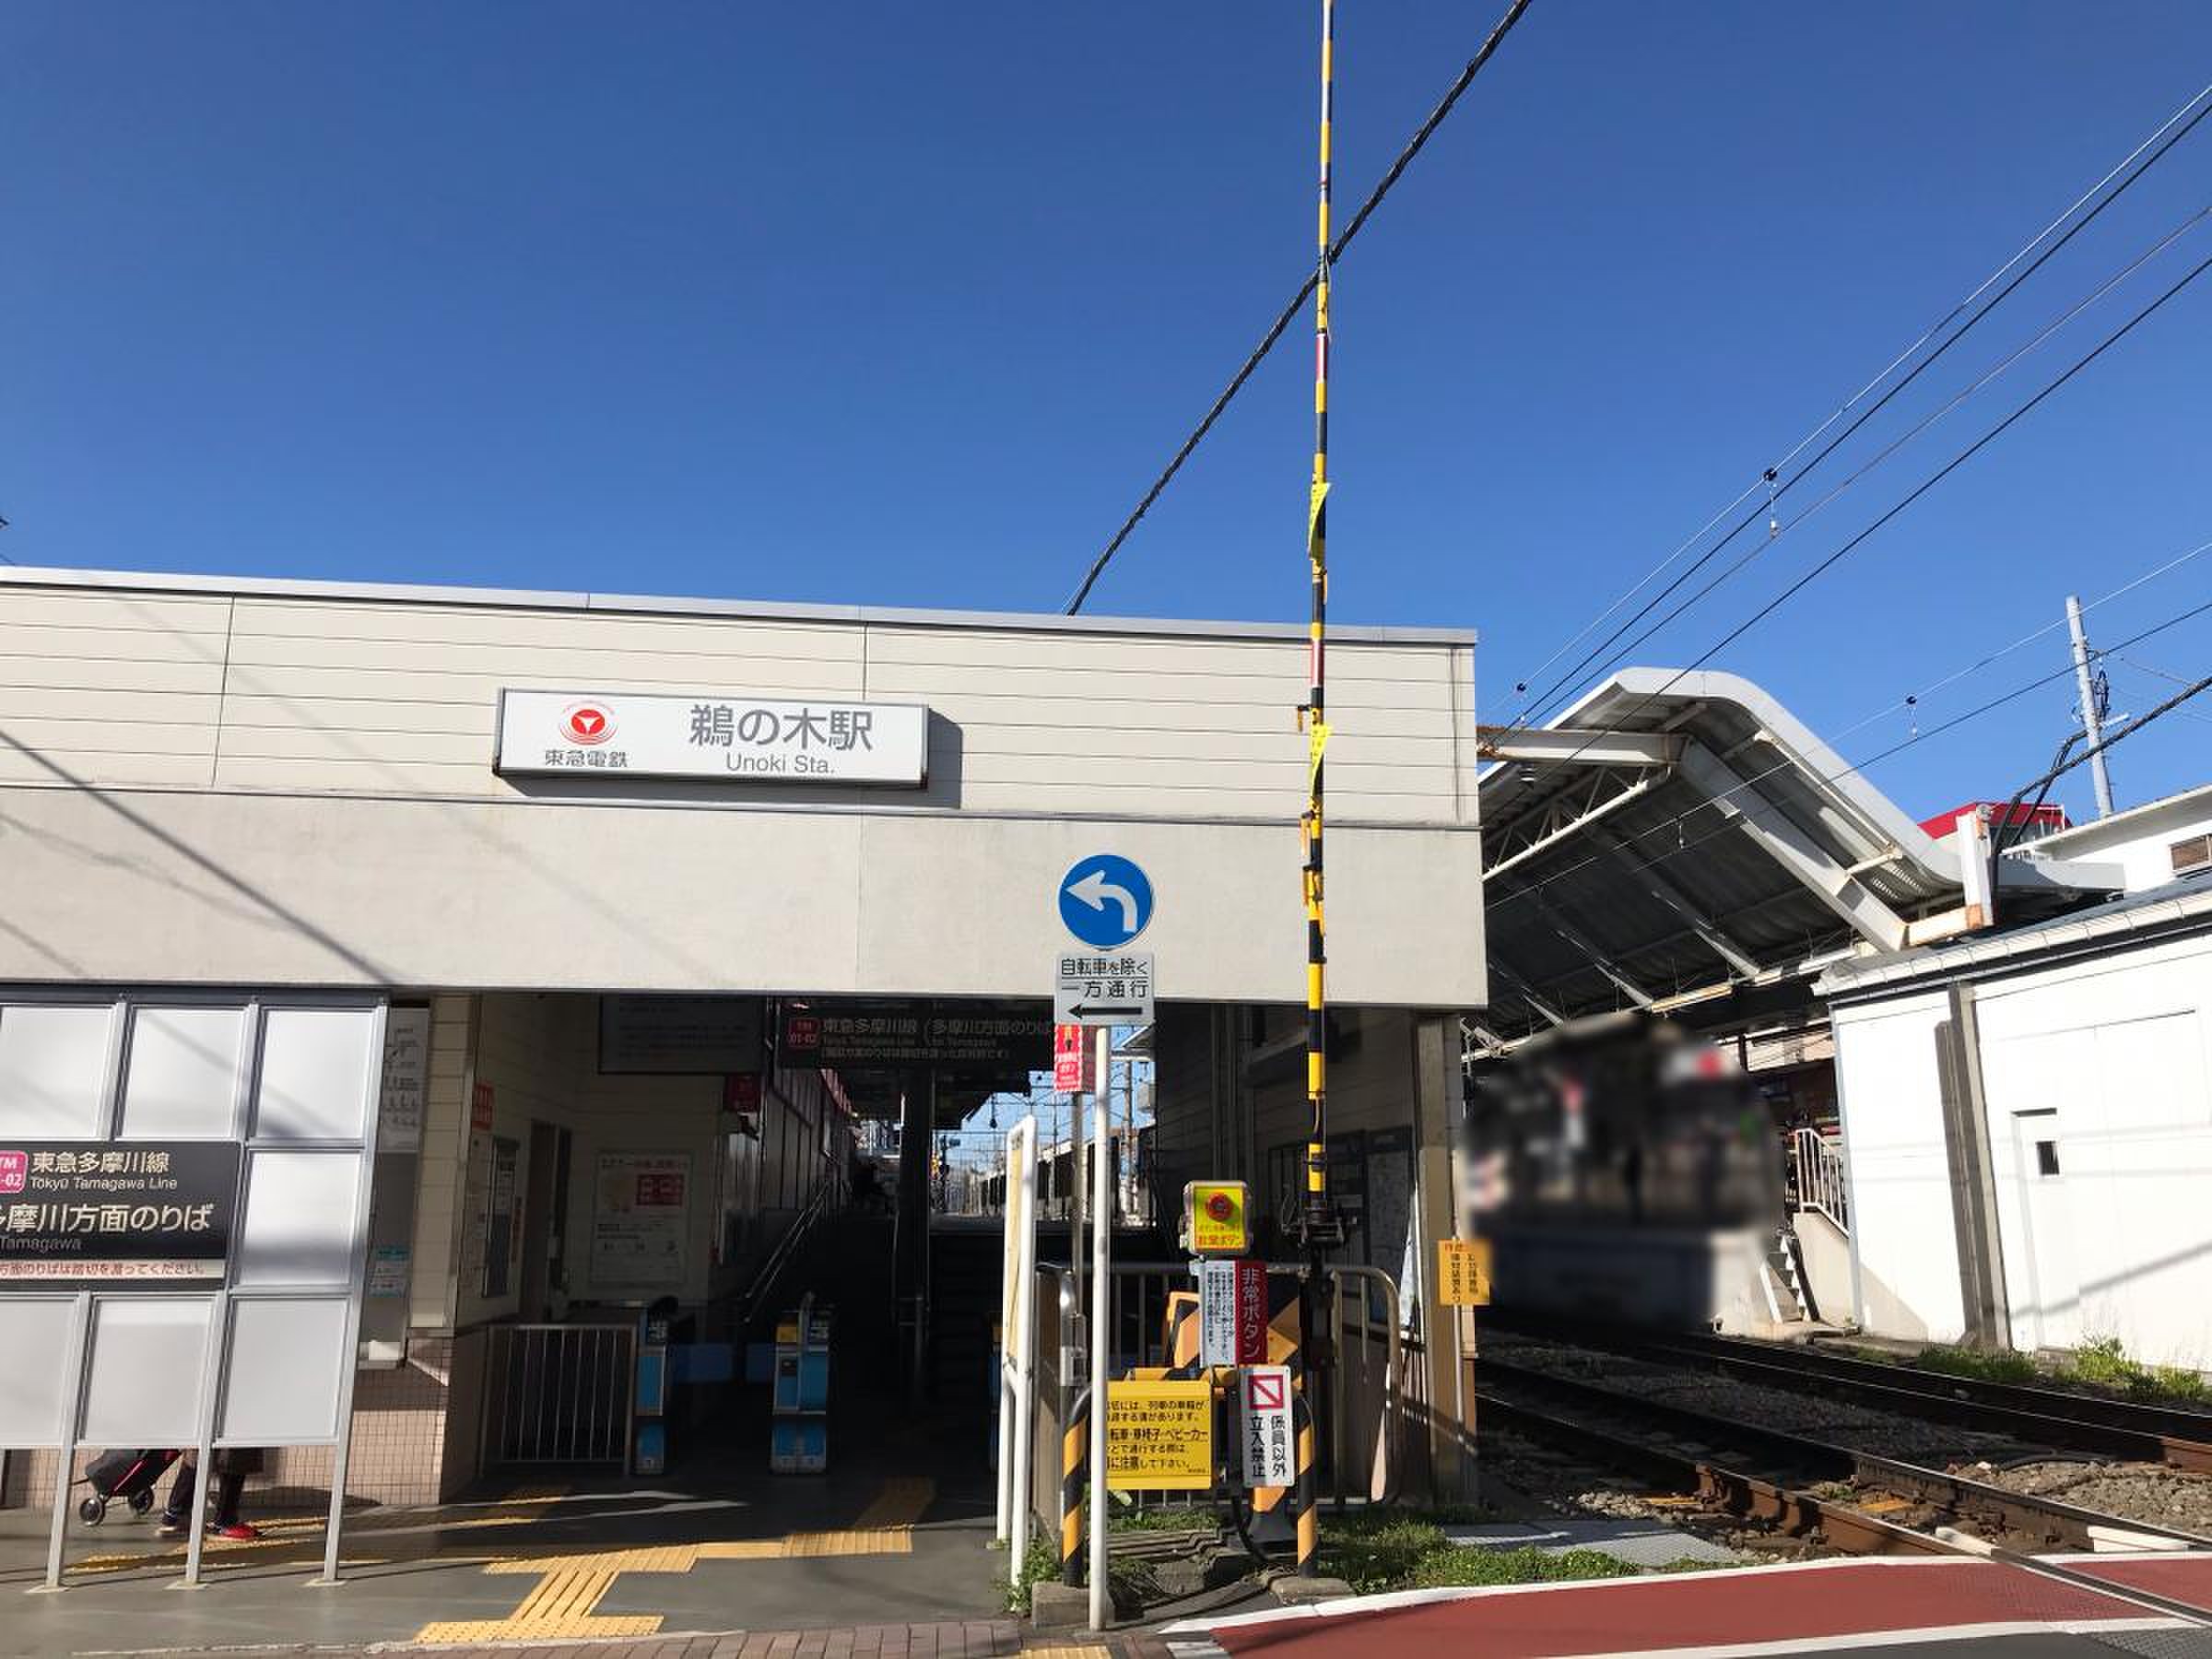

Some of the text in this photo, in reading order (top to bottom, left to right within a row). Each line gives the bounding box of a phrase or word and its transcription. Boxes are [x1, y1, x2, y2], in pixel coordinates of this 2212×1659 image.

[689, 703, 873, 751] 鵜の木駅
[545, 749, 628, 768] 東急電鉄
[726, 752, 835, 774] Unoki Sta.
[1061, 958, 1147, 975] 自転車を除く
[1061, 981, 1149, 998] 一方通行
[31, 1151, 171, 1174] 東急多摩川線
[0, 1173, 22, 1187] -02
[72, 1177, 146, 1191] Tamagawa
[148, 1178, 178, 1190] Line
[1241, 1267, 1261, 1357] 非常ボタン
[1250, 1415, 1266, 1477] 立入禁止
[1271, 1415, 1286, 1477] 係員以外
